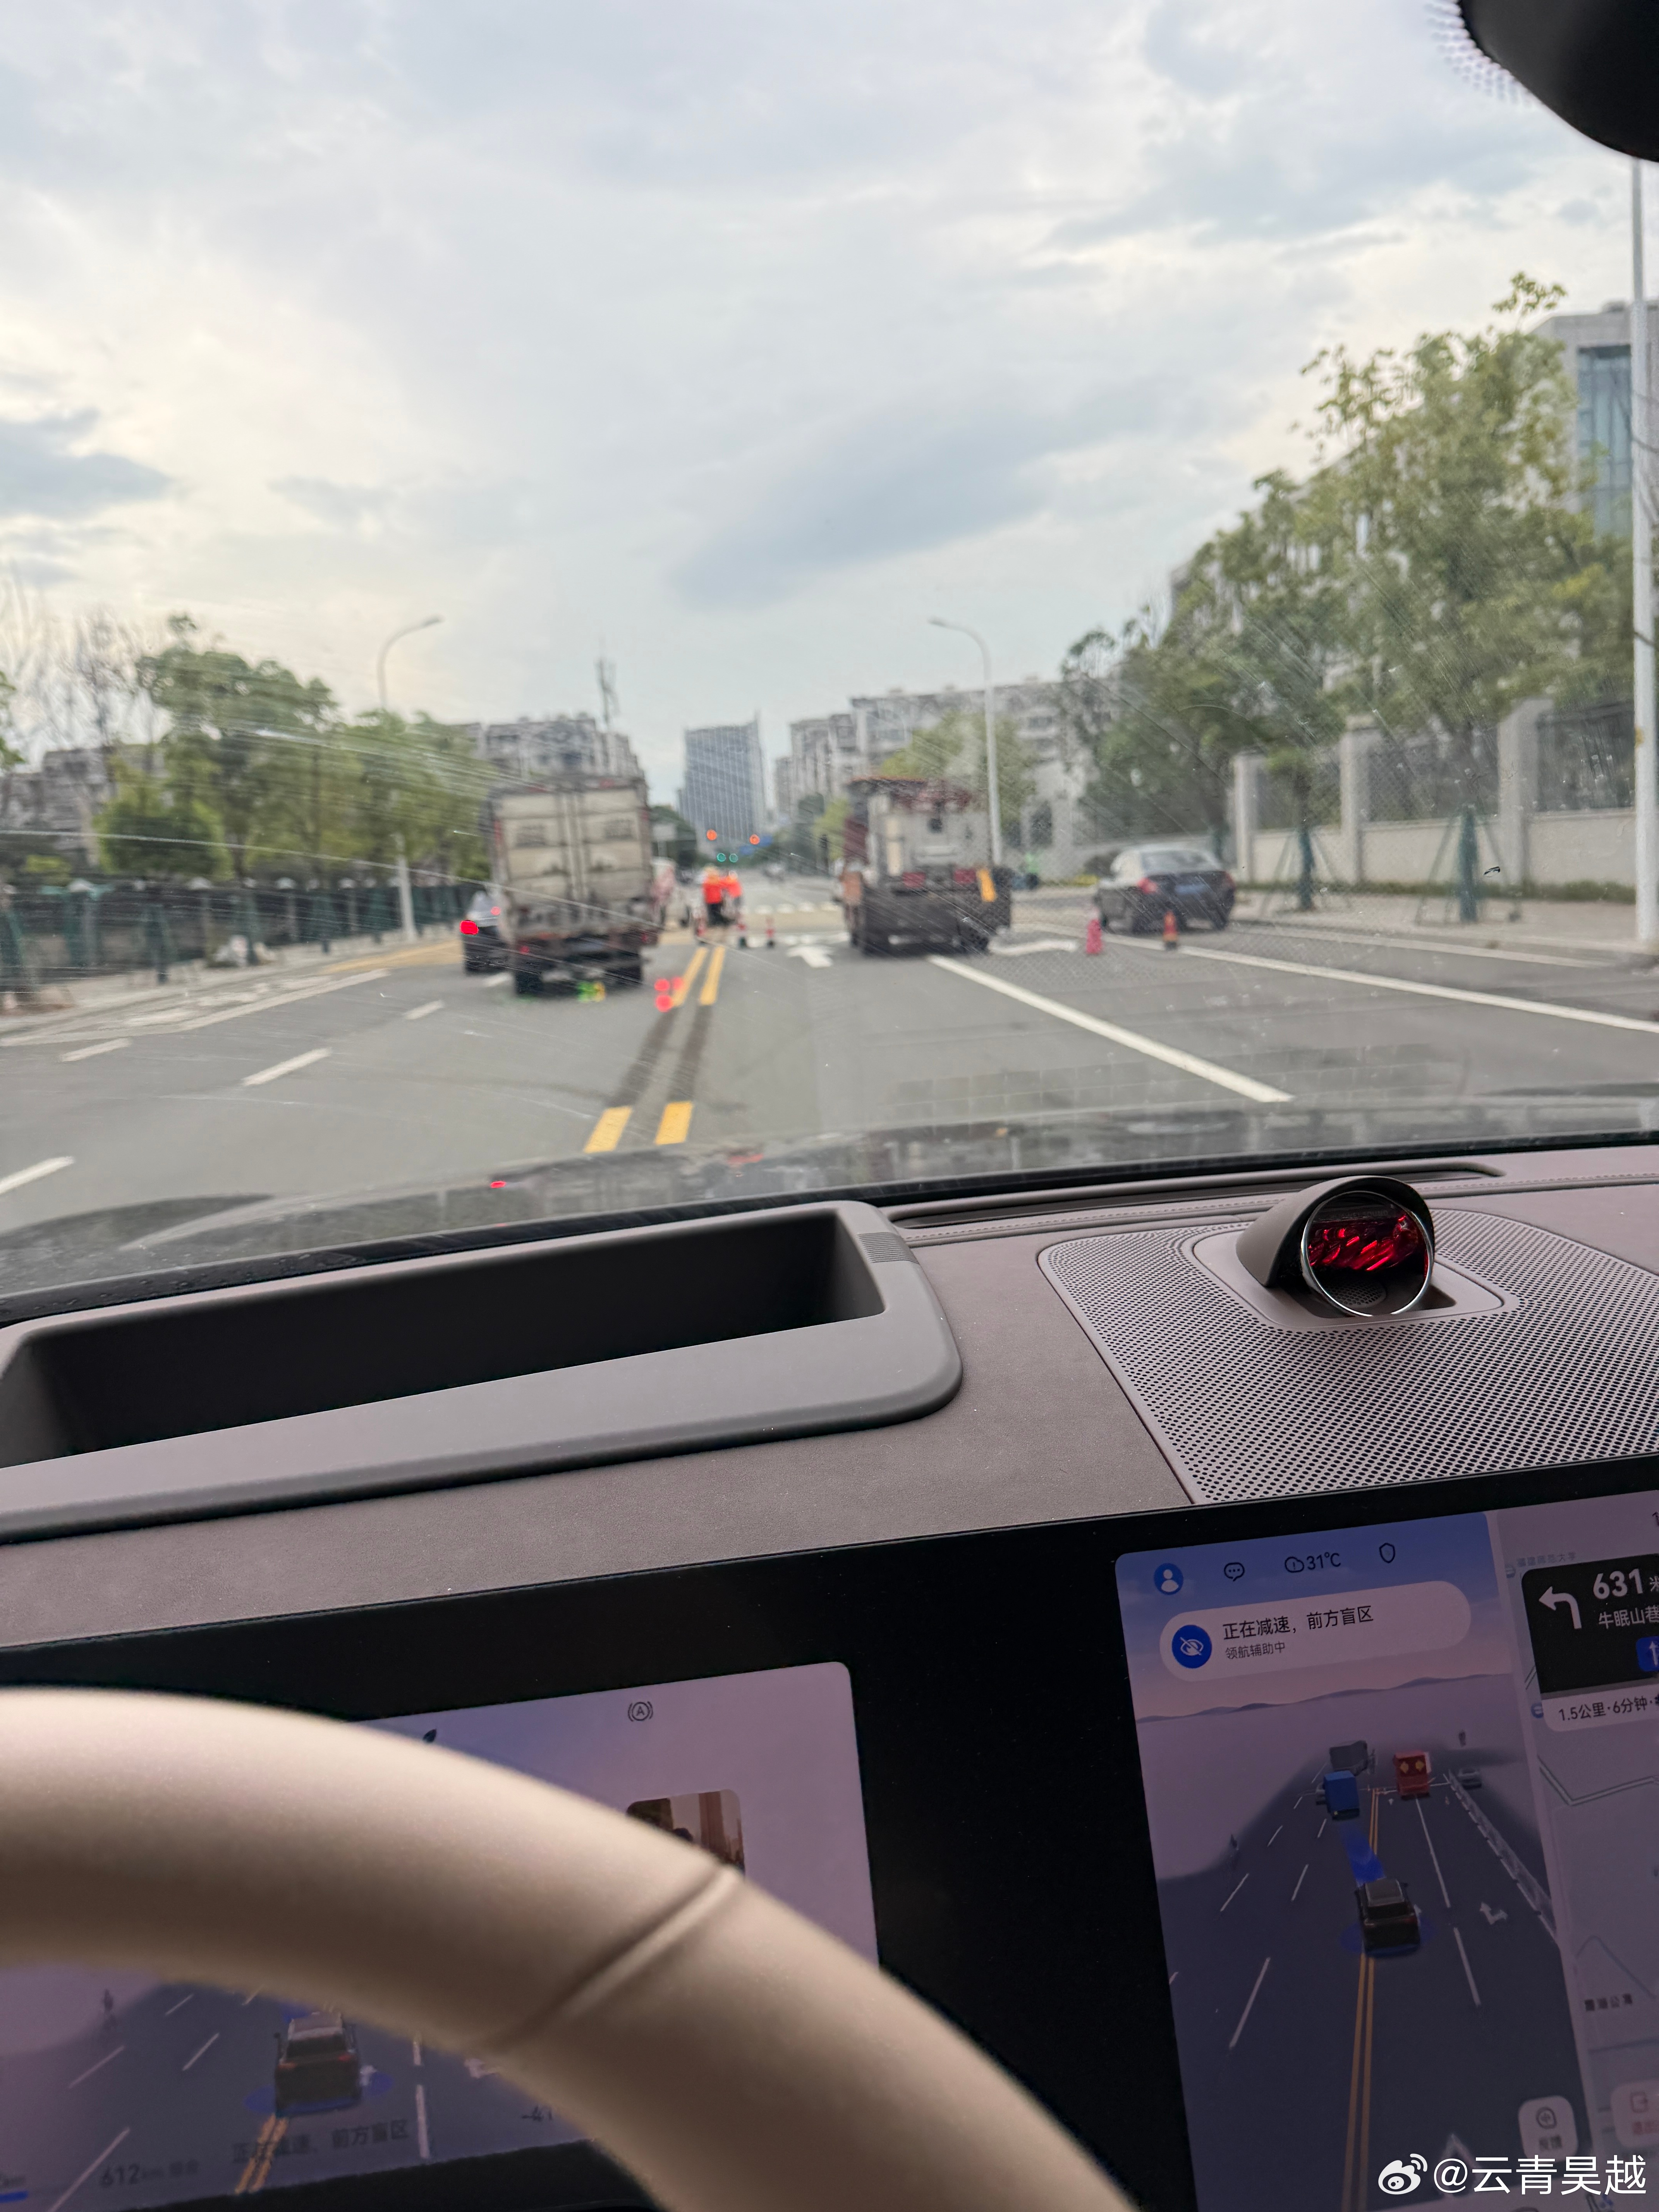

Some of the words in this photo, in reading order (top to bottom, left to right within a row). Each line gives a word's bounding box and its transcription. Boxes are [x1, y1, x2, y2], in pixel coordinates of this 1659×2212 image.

[1306, 1551, 1341, 1570] 31°C
[1593, 1568, 1644, 1600] 631
[1225, 1641, 1286, 1660] 领航辅助中
